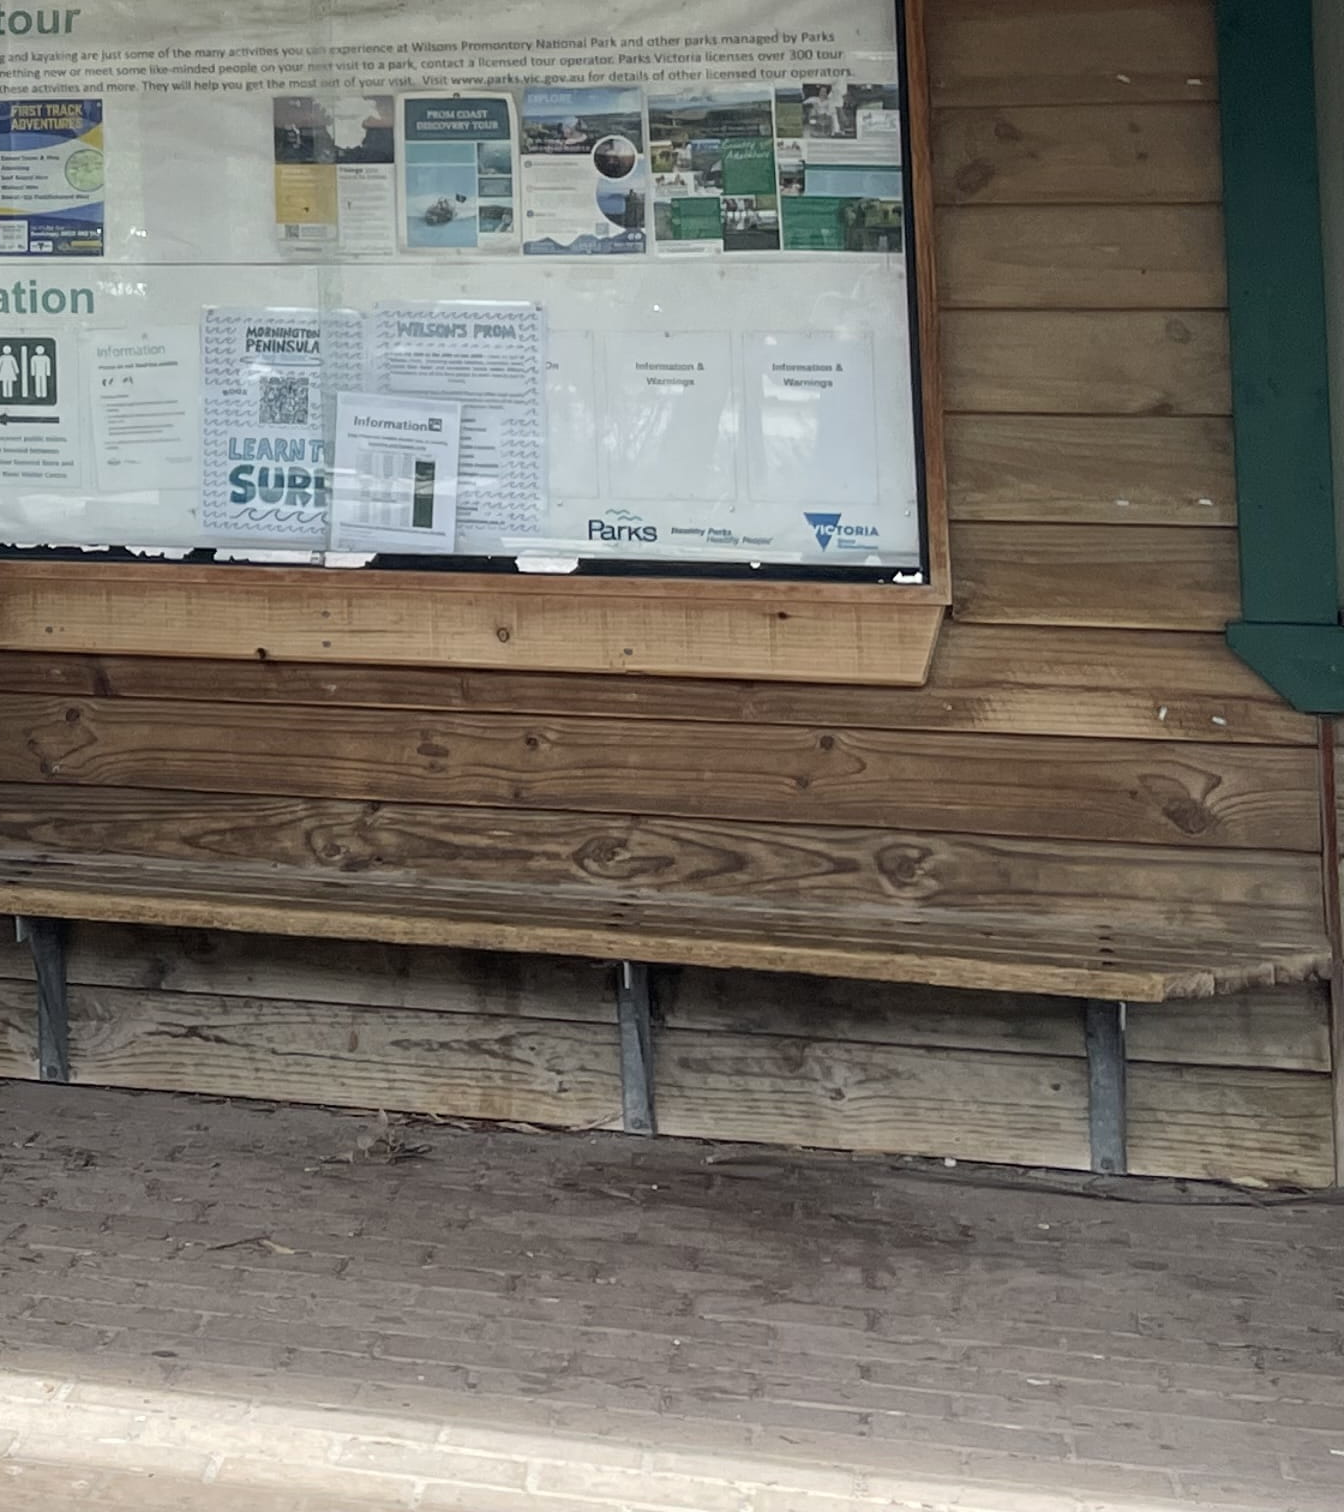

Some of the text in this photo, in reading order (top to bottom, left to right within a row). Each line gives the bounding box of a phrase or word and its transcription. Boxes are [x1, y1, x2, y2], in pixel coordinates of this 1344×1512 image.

[7, 51, 28, 62] and
[31, 51, 78, 63] kayaking
[80, 52, 99, 61] are
[100, 49, 121, 62] just
[124, 50, 154, 59] some
[157, 47, 170, 58] of
[172, 47, 192, 58] the
[194, 47, 226, 58] many
[281, 46, 303, 57] you
[411, 41, 458, 53] Wilsons
[461, 39, 532, 51] Promontory
[535, 37, 587, 49] National
[590, 36, 616, 48] Park
[620, 36, 643, 47] and
[646, 35, 680, 47] other
[684, 34, 717, 46] parks
[721, 32, 779, 45] managed
[782, 31, 797, 44] by
[801, 31, 835, 43] Parks
[43, 68, 66, 77] new
[84, 66, 112, 76] meet
[116, 66, 146, 76] some
[218, 62, 258, 75] people
[335, 60, 359, 71] visit
[362, 60, 375, 70] to
[420, 58, 464, 70] contact
[478, 56, 527, 68] licensed
[530, 55, 555, 66] tour
[618, 53, 651, 65] Parks
[654, 52, 702, 64] Victoria
[705, 50, 754, 63] licenses
[757, 51, 785, 62] over
[789, 49, 813, 61] 300
[816, 49, 843, 60] tour
[422, 74, 448, 86] Visit
[588, 70, 605, 82] for
[608, 69, 649, 82] details
[652, 69, 665, 81] of
[668, 68, 703, 80] other
[705, 68, 757, 80] licensed
[760, 67, 786, 79] tour
[12, 103, 83, 118] FIRST TRACK
[456, 109, 488, 119] COAST
[245, 326, 321, 339] MORNINGTON
[245, 338, 321, 354] PENINSULA
[353, 415, 428, 432] Information
[228, 437, 306, 463] LEARN
[588, 519, 658, 542] Parks
[814, 524, 880, 537] VICTORIA
